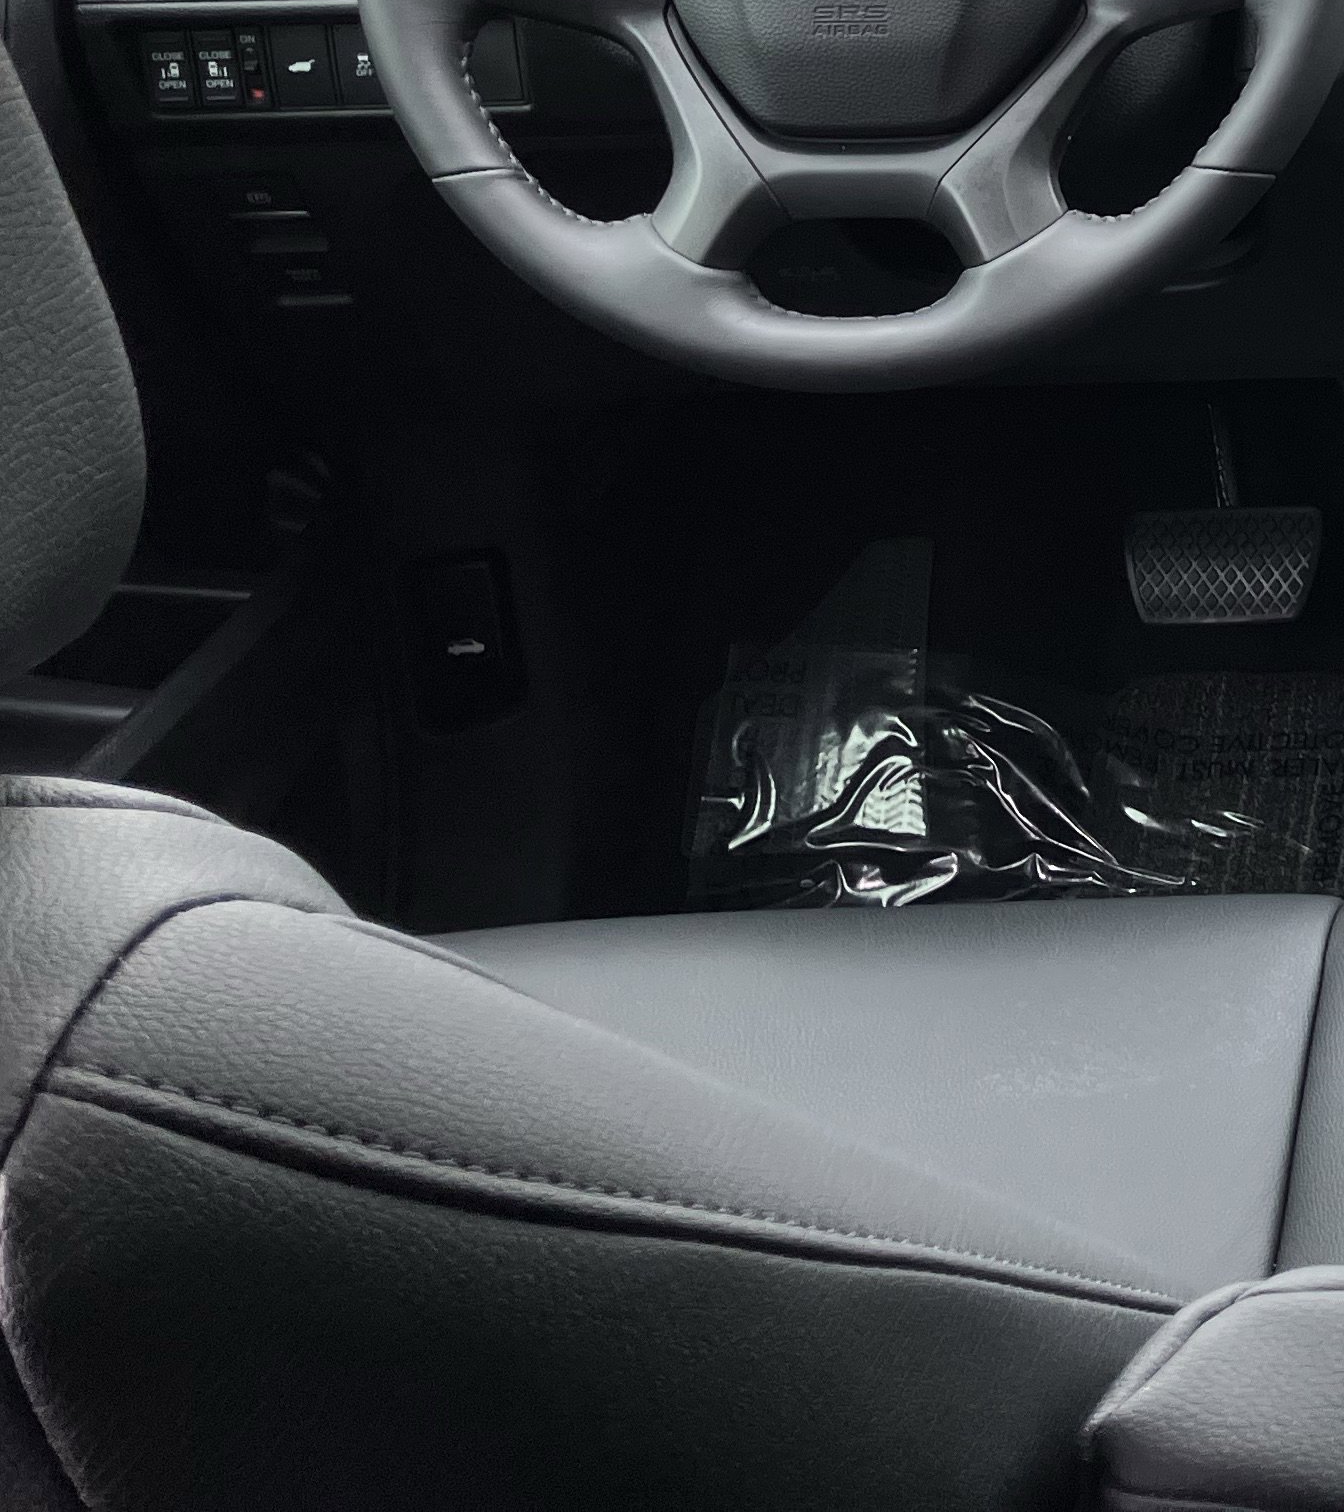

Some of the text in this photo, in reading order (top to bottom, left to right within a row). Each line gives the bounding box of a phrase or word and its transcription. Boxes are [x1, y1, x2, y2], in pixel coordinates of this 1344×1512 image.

[812, 4, 889, 21] SRS
[812, 24, 890, 37] AIRBAG
[159, 80, 187, 90] OPEN
[205, 79, 234, 89] OPEN
